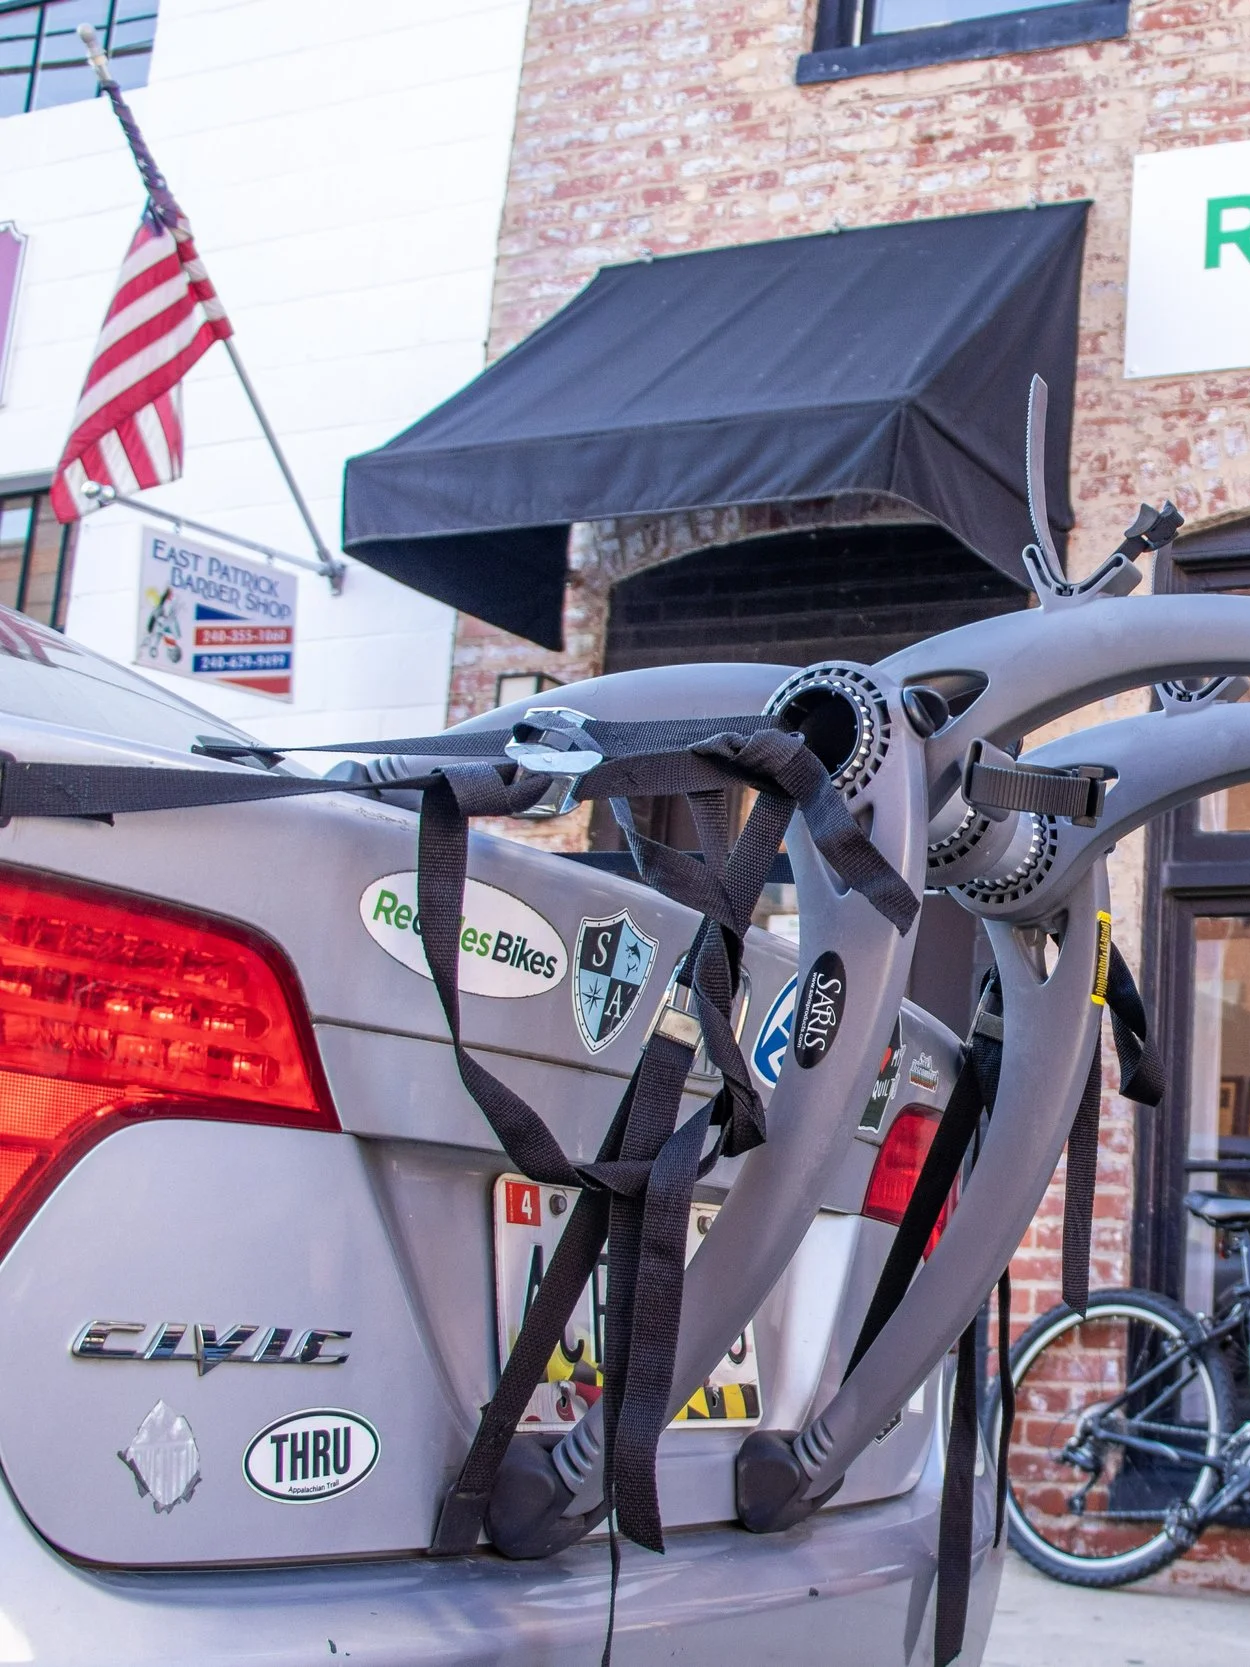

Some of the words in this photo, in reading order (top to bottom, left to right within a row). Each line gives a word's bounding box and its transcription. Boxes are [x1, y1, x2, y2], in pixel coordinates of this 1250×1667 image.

[153, 538, 202, 571] EAST
[208, 557, 280, 597] PATRICK
[170, 567, 241, 611] BARBER
[245, 593, 292, 620] SHOP
[592, 931, 612, 967] S
[604, 984, 622, 1018] A
[797, 972, 818, 1048] www.sarisproducts.com
[804, 973, 842, 1051] SARIS
[521, 1190, 532, 1220] 4
[71, 1320, 352, 1377] CIVIC
[271, 1426, 351, 1483] THRU
[288, 1484, 325, 1494] Appalachian
[326, 1479, 340, 1489] Trail
